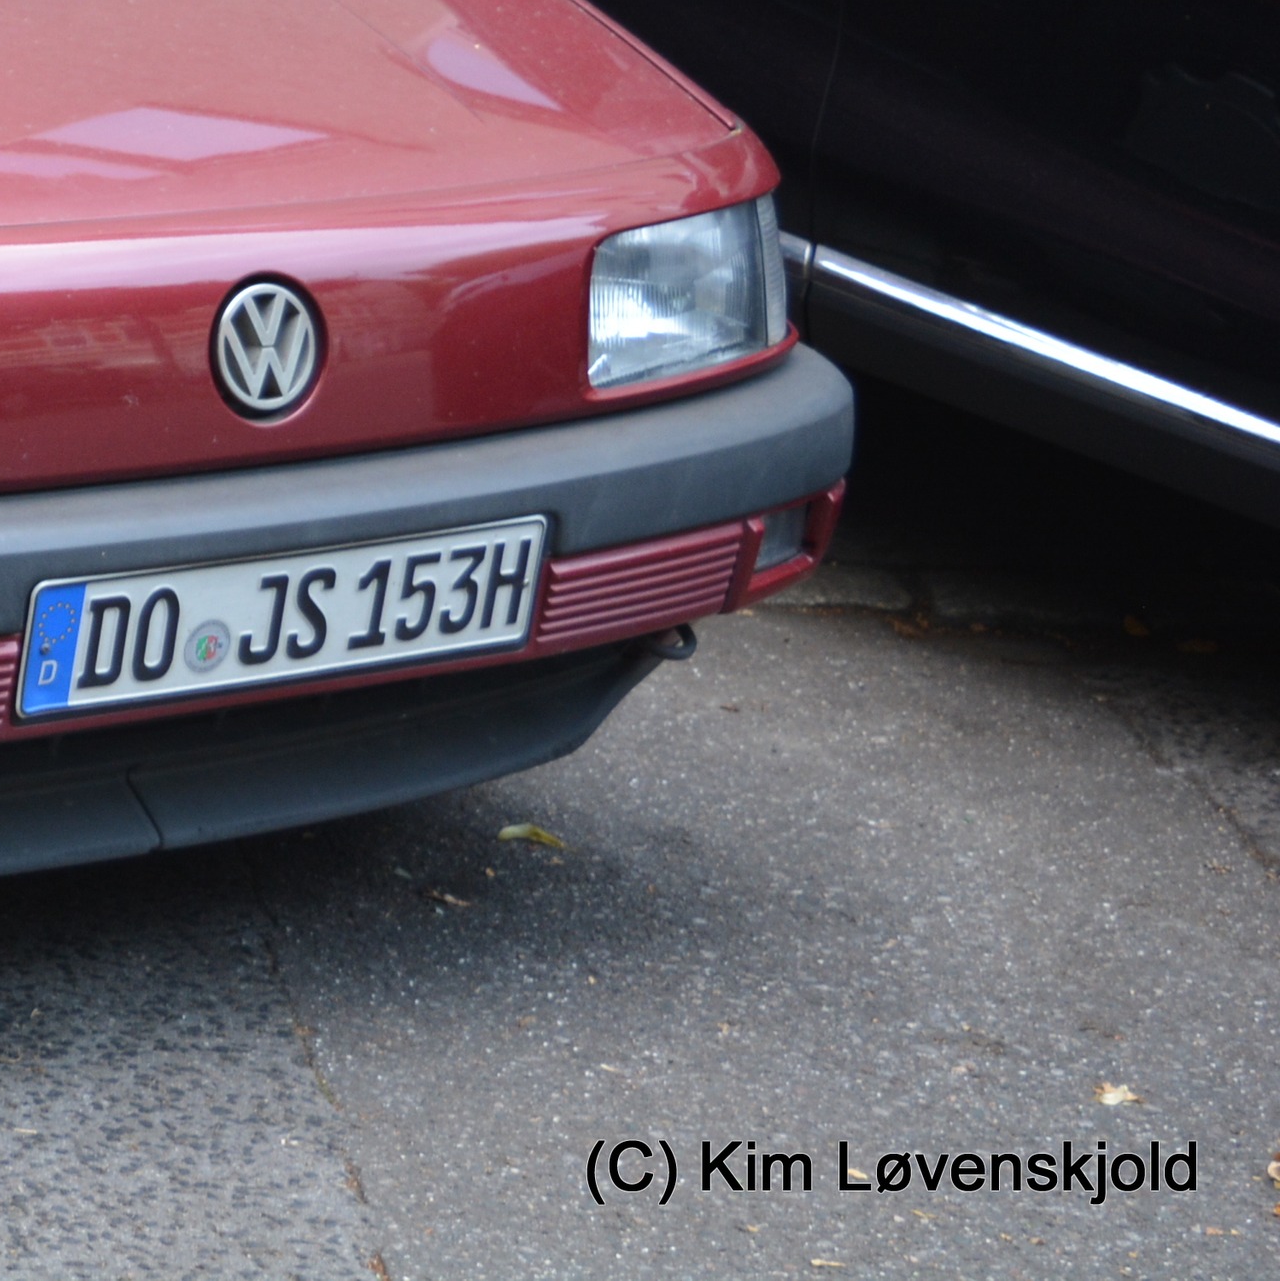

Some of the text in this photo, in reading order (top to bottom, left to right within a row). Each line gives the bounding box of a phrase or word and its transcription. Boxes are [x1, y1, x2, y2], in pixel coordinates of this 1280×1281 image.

[38, 538, 532, 689] D DO JS 153H
